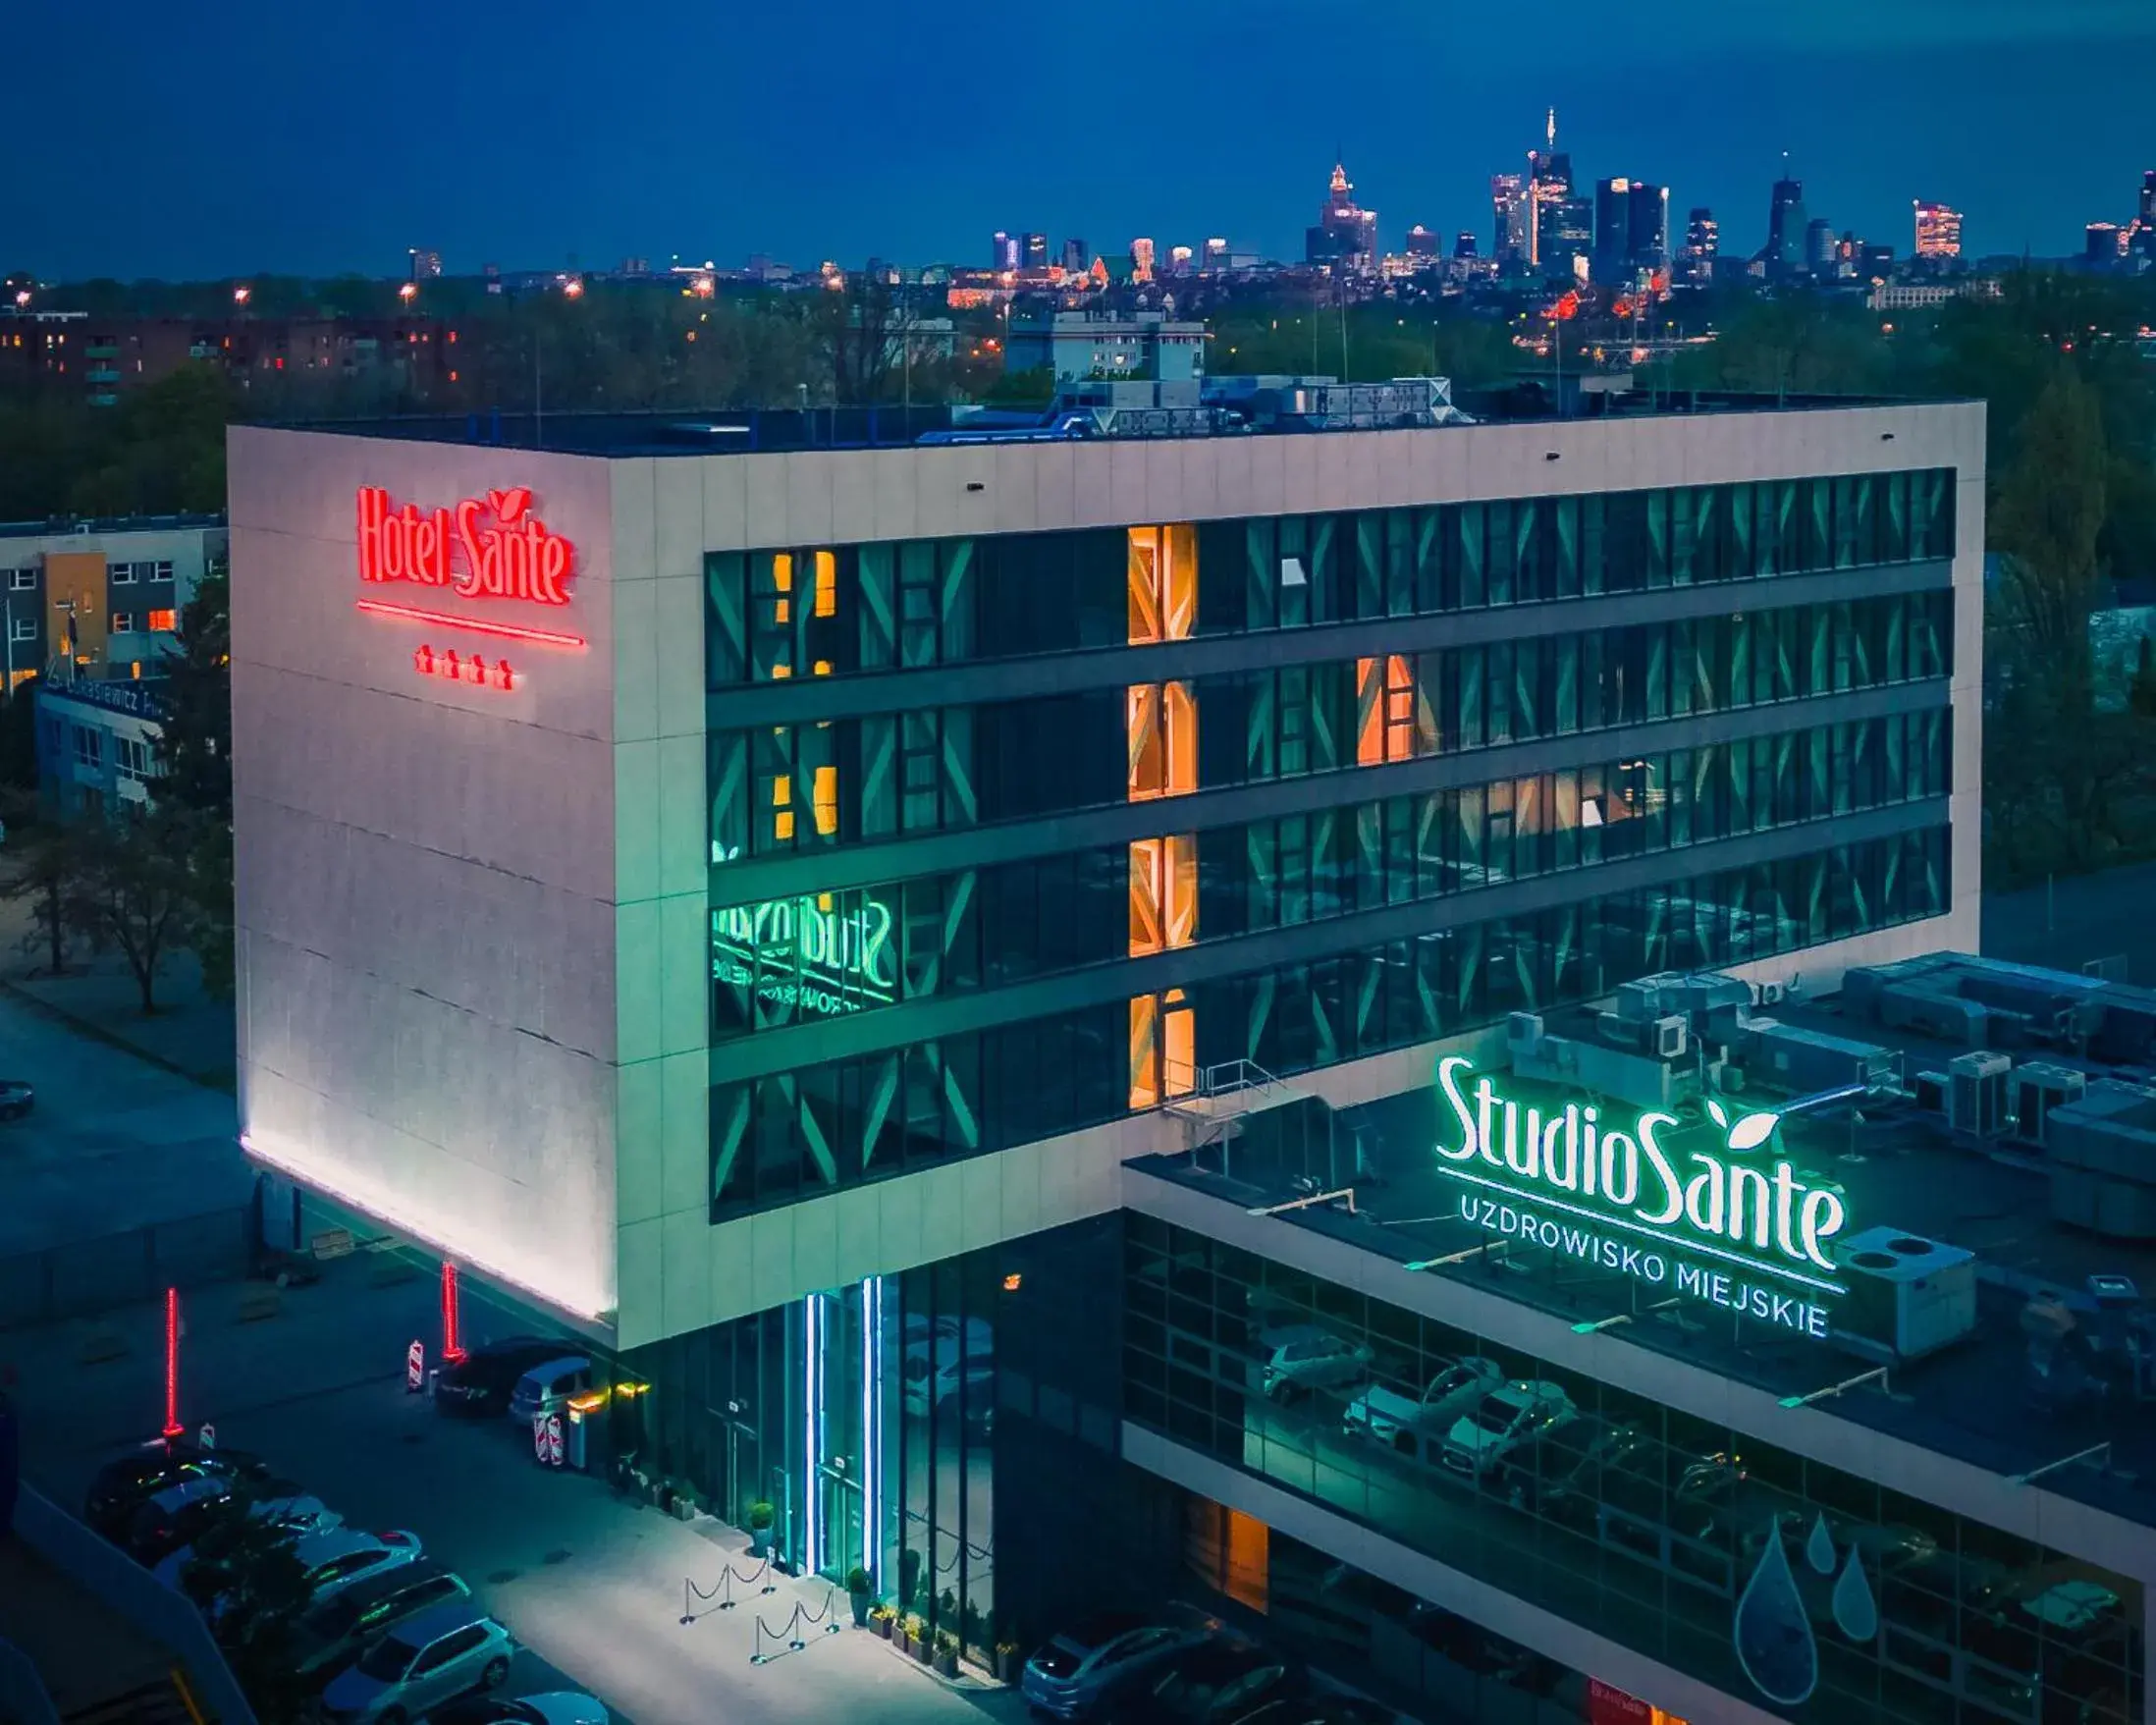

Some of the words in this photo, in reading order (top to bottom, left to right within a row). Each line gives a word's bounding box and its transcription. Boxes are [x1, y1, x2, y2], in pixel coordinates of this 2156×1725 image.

[358, 486, 451, 585] Hotel
[1460, 1194, 1665, 1283] UZDROWISKO
[1677, 1263, 1829, 1339] MIEJSKIE
